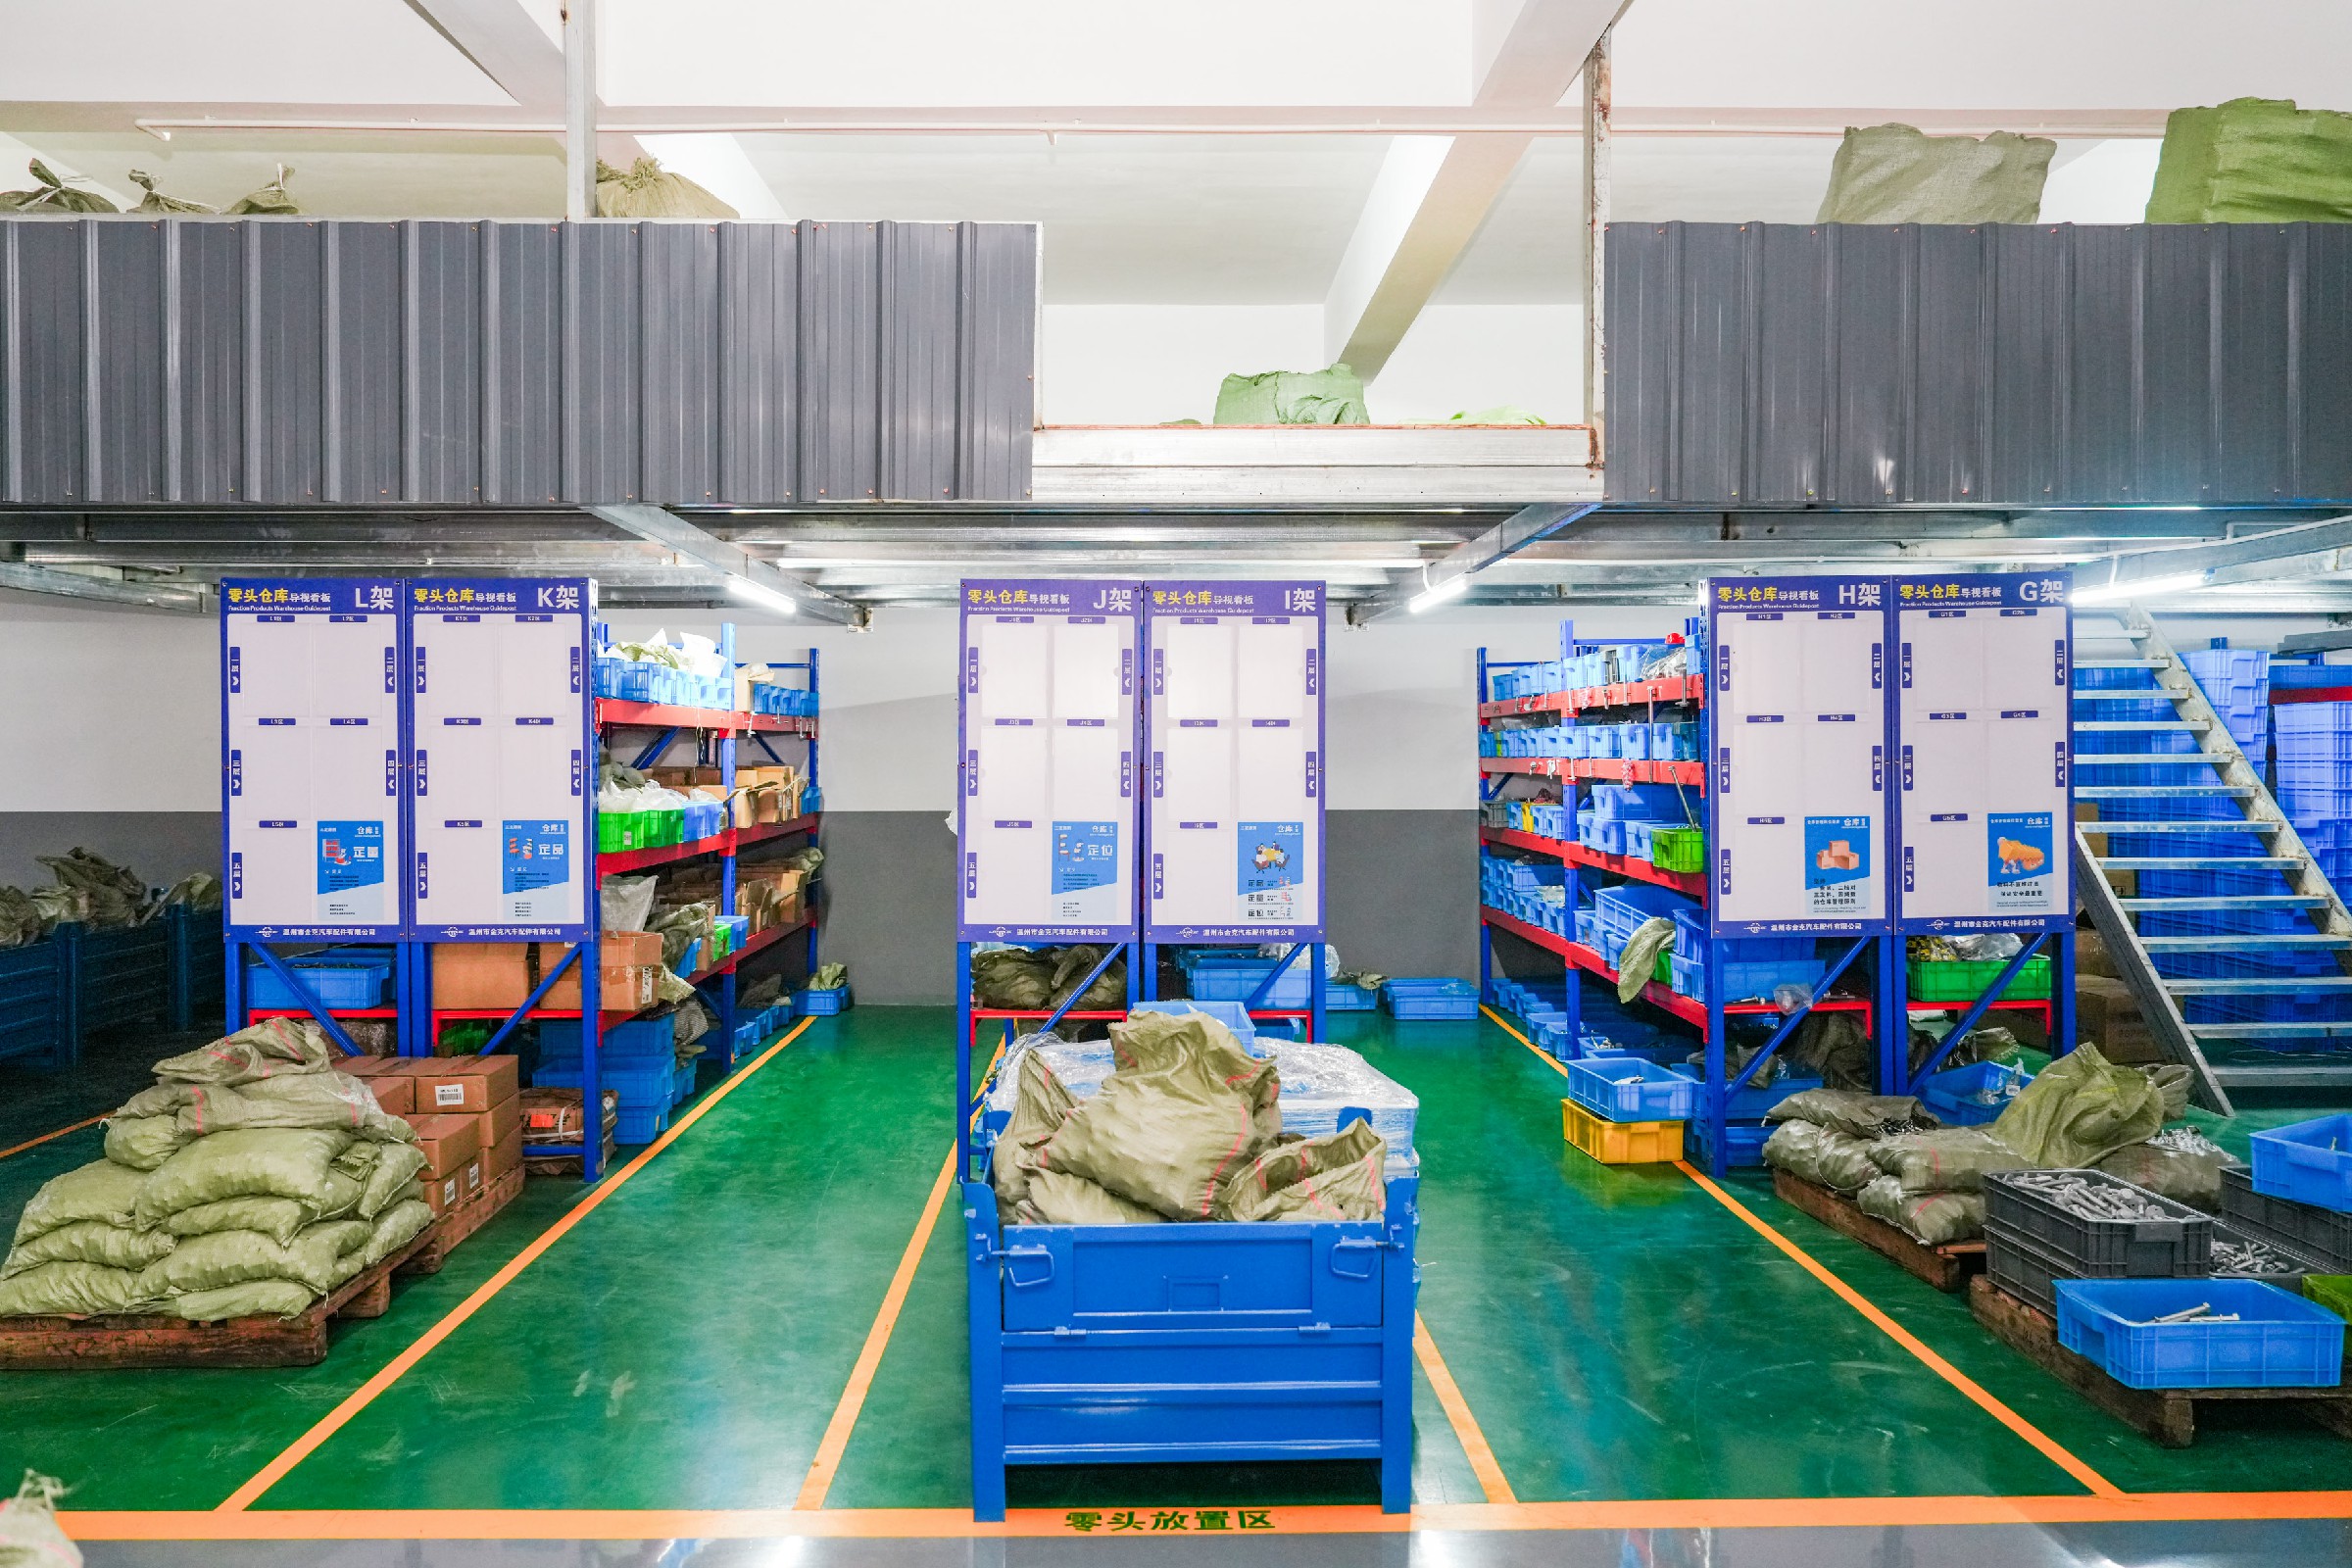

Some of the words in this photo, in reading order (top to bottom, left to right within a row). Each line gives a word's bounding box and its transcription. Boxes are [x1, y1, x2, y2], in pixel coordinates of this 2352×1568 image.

[355, 586, 394, 611] L架
[537, 585, 580, 611] K架
[1838, 583, 1882, 607] H架
[2019, 578, 2065, 604] G架
[1093, 588, 1132, 612] J架
[1285, 588, 1317, 612] I架
[542, 823, 559, 832] 仓库
[1277, 824, 1294, 833] 仓库
[1843, 817, 1860, 826] 仓库
[2027, 816, 2043, 825] 仓库
[357, 826, 373, 835] 仓库
[538, 843, 564, 856] 定品
[1087, 844, 1113, 857] 定位
[1064, 1510, 1276, 1532] 零头放置区
